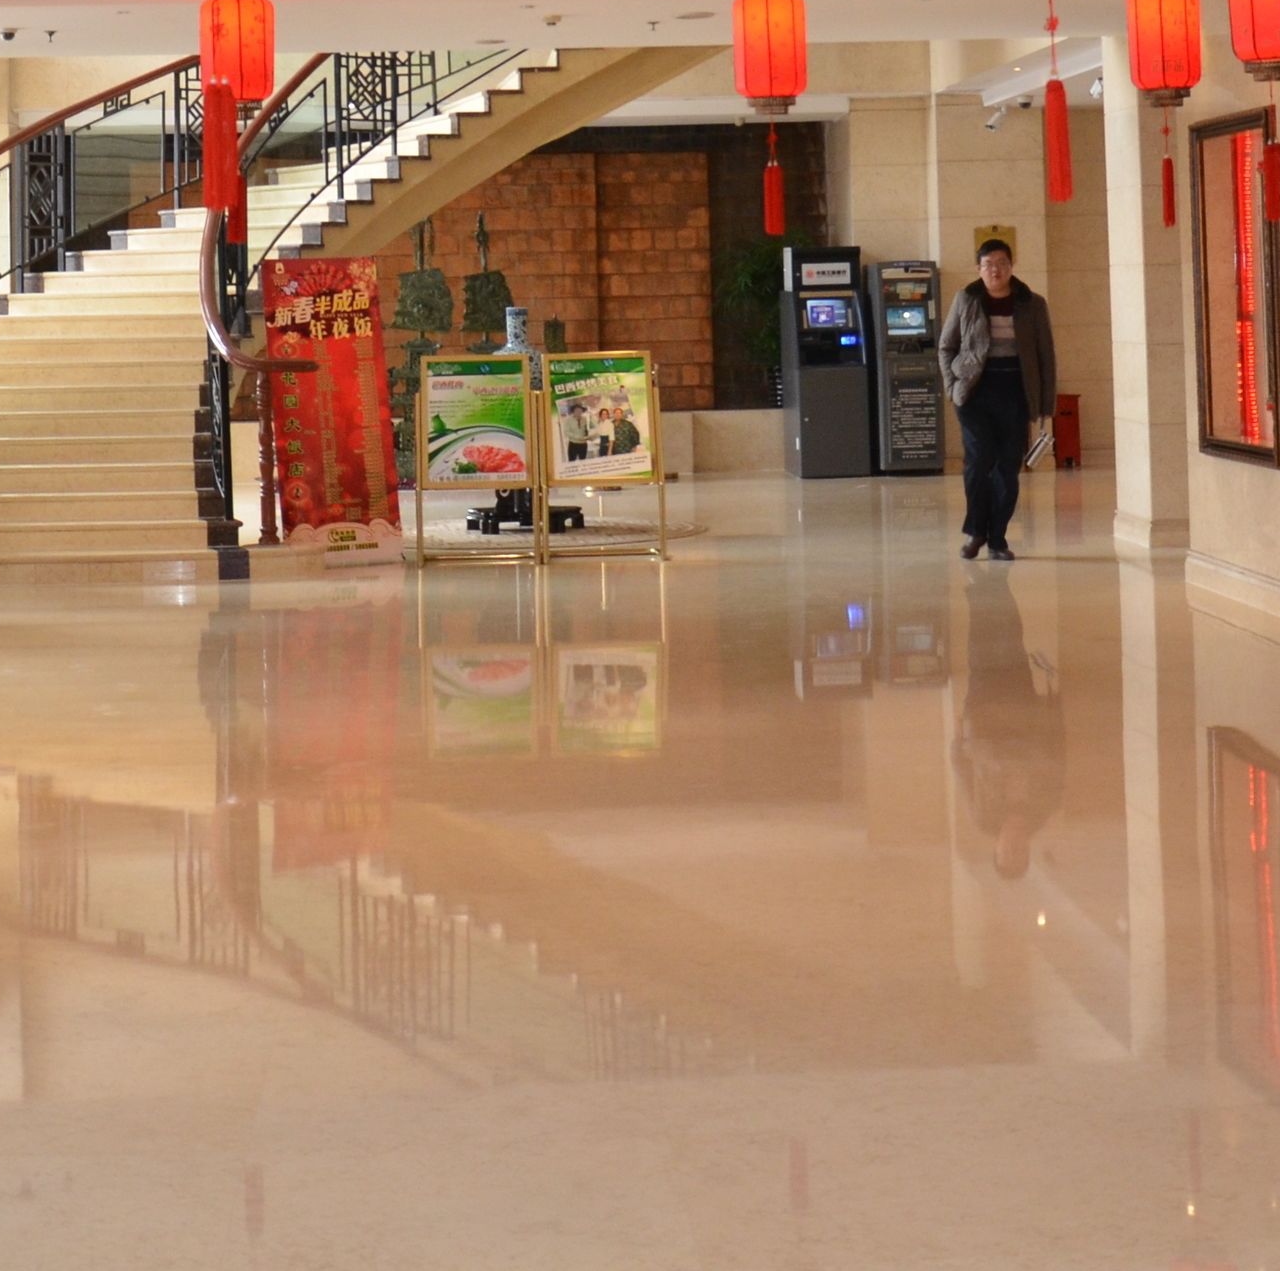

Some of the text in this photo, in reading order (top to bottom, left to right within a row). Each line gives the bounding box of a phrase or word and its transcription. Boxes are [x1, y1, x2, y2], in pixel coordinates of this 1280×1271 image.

[267, 289, 370, 328] 新春半成品
[309, 317, 373, 341] 年夜饭
